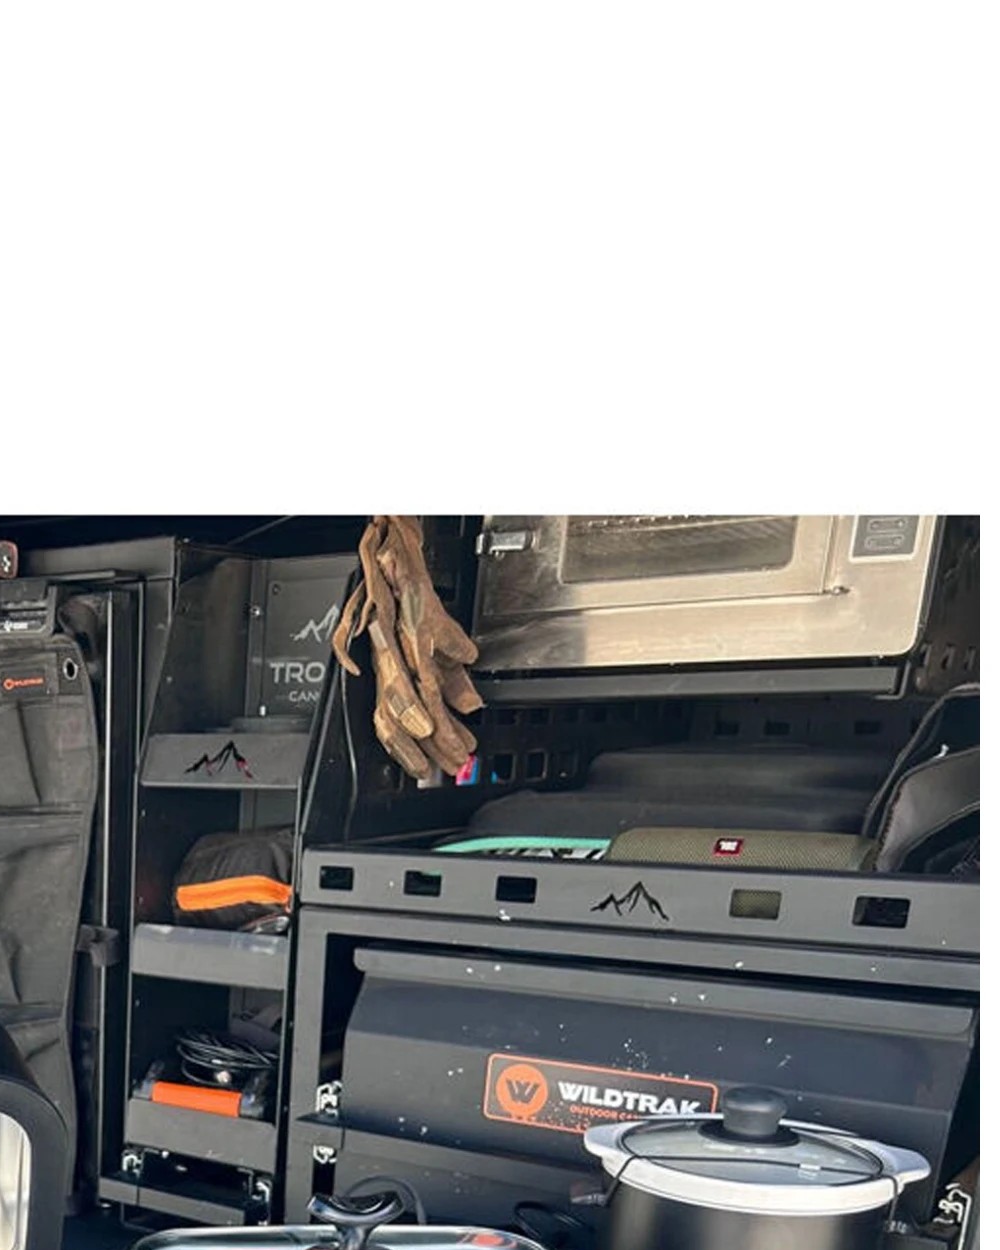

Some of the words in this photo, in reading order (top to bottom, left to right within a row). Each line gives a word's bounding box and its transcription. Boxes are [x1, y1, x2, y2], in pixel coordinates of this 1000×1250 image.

[269, 661, 326, 684] TRO
[288, 691, 320, 702] CAN
[557, 1080, 701, 1114] WILDTRAK
